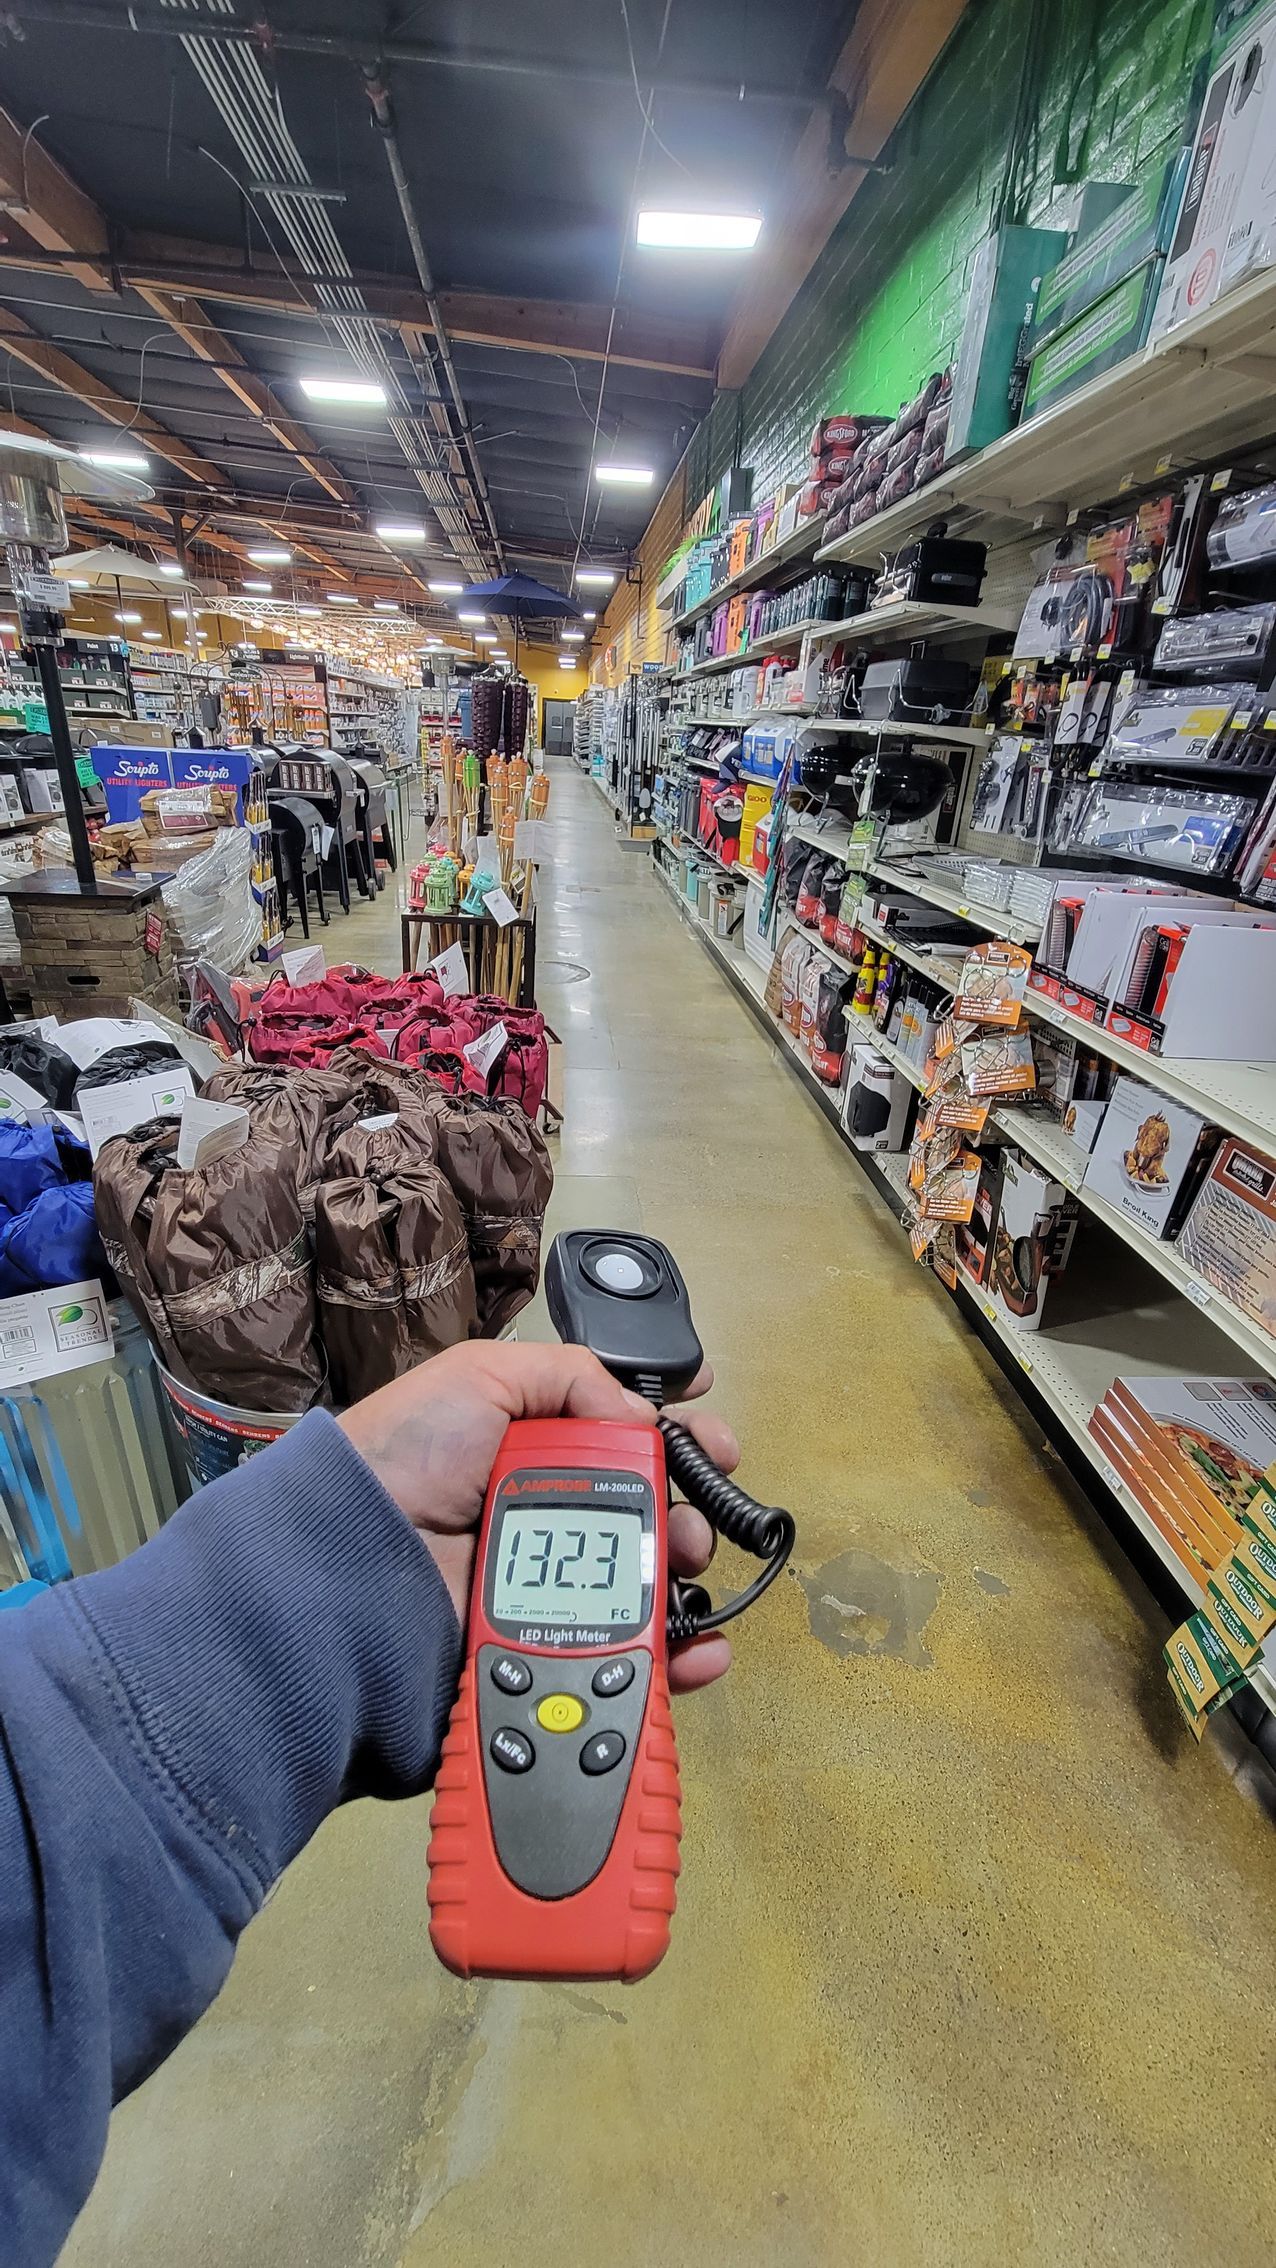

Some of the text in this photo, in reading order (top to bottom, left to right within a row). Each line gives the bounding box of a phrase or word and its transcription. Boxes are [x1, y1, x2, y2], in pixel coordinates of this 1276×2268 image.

[827, 428, 854, 440] KINGSFORD
[109, 643, 119, 652] 13
[314, 654, 323, 663] 14
[422, 661, 431, 670] 14
[114, 761, 159, 777] Scripto
[184, 764, 229, 781] Scripto
[107, 777, 168, 787] UTILITY LIGHTERS
[1122, 1197, 1160, 1228] Broil King
[61, 1328, 102, 1342] SEASONAL
[66, 1335, 98, 1346] TRENDS
[216, 1433, 228, 1442] CAN
[520, 1479, 645, 1494] AMPROBE LM-200LED
[505, 1529, 620, 1589] 132.3
[1246, 1573, 1270, 1599] GIFT CARD
[1225, 1571, 1264, 1621] OUTDOOR
[611, 1608, 630, 1620] FC
[1220, 1598, 1242, 1627] GIFT CARD
[520, 1629, 611, 1644] LED Light Meter
[1209, 1627, 1229, 1655] GIFT CARD
[498, 1660, 624, 1687] M-H D-H
[1176, 1641, 1205, 1693] OUTDOOR
[1172, 1666, 1187, 1695] GIFT CARD
[596, 1743, 609, 1760] R
